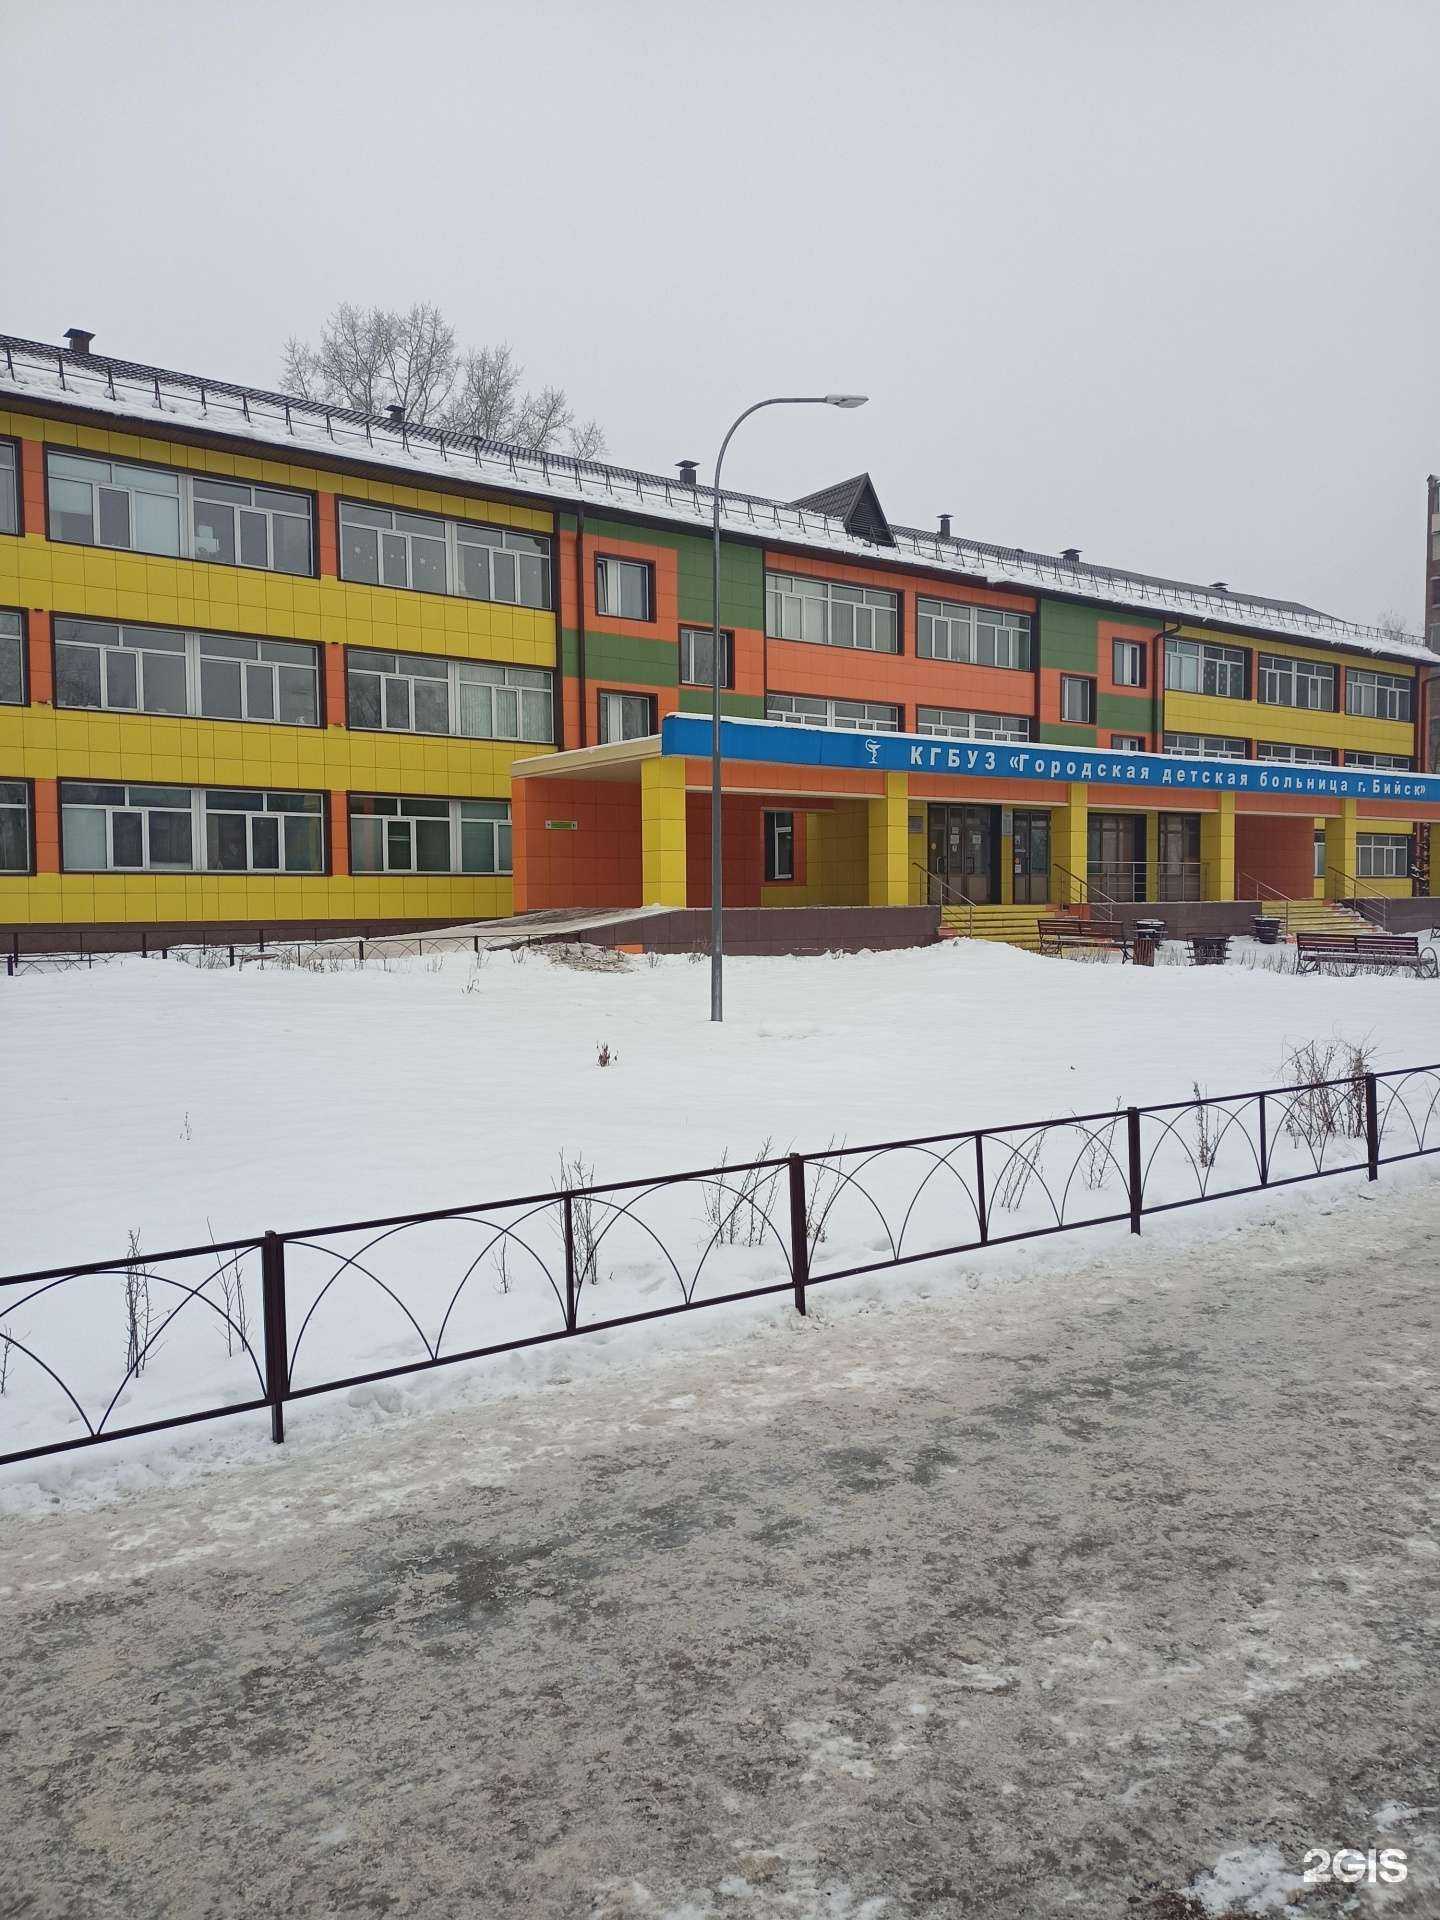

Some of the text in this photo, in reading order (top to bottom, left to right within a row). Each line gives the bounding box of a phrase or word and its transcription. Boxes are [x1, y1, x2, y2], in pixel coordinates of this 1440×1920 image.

[910, 745, 1426, 796] КГБУЗ «Городская детская больница г. Бийск»
